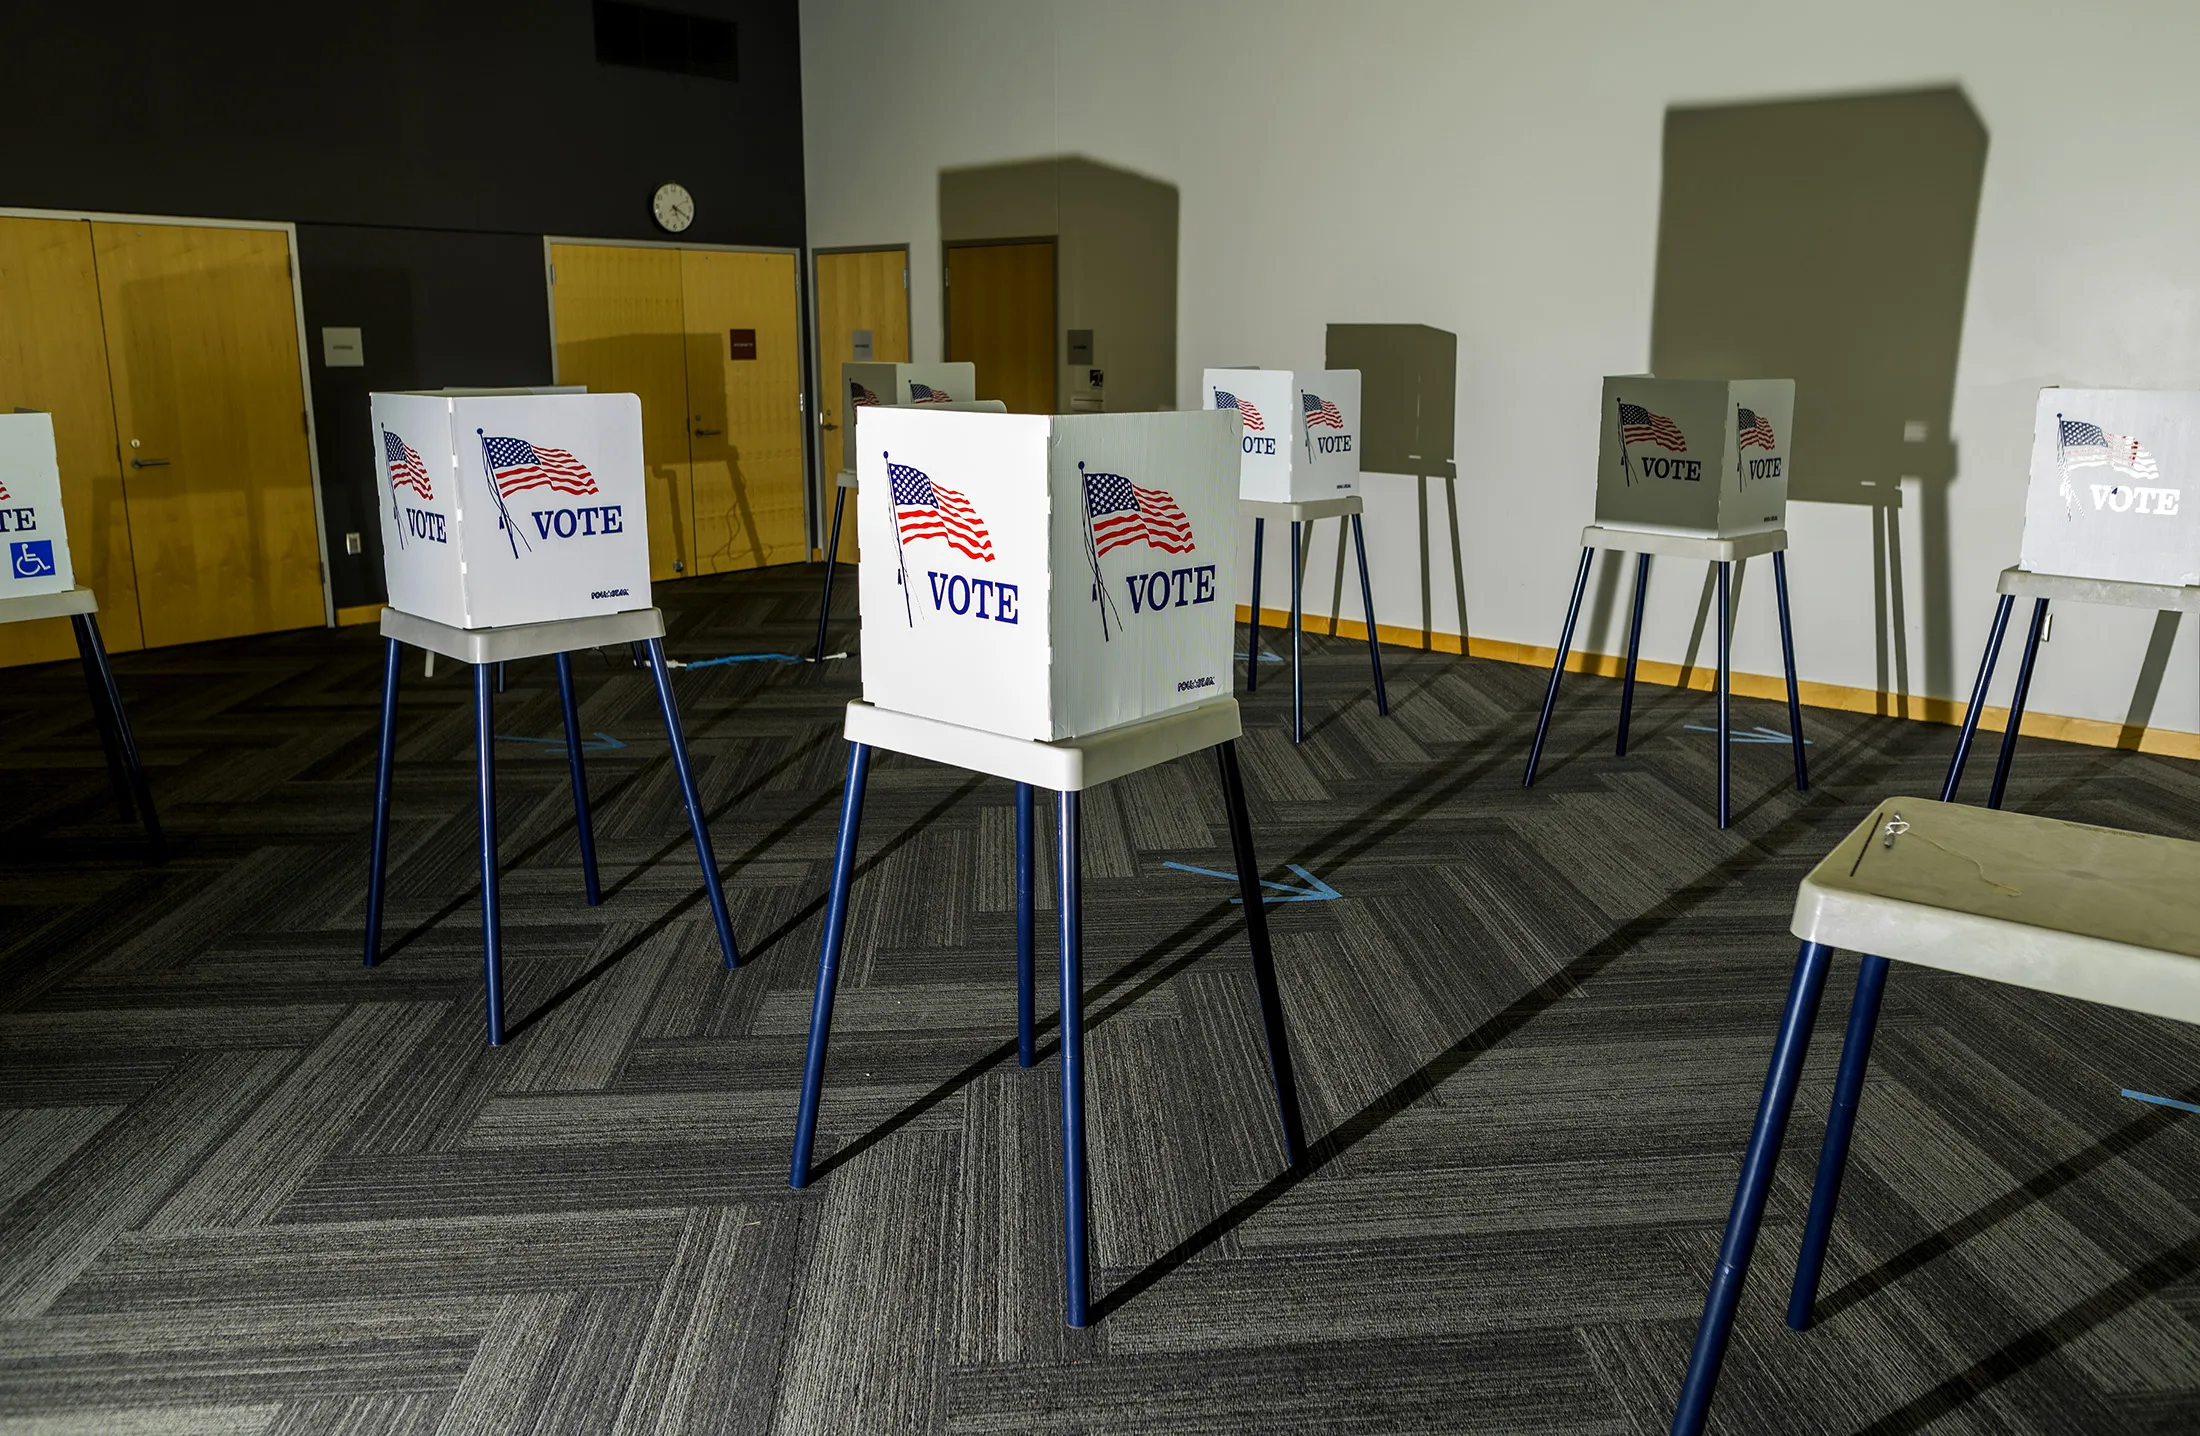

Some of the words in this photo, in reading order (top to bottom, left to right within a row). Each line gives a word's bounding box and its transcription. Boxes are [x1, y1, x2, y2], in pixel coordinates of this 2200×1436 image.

[1242, 436, 1276, 455] OTE
[1317, 435, 1352, 454] VOTE
[1641, 457, 1702, 482] VOTE
[1749, 457, 1782, 480] VOTE
[2089, 484, 2181, 516] VOTE
[0, 508, 37, 532] TE
[406, 508, 447, 543] VOTE
[531, 505, 623, 540] VOTE
[927, 571, 1018, 625] VOTE
[1125, 564, 1216, 614] VOTE
